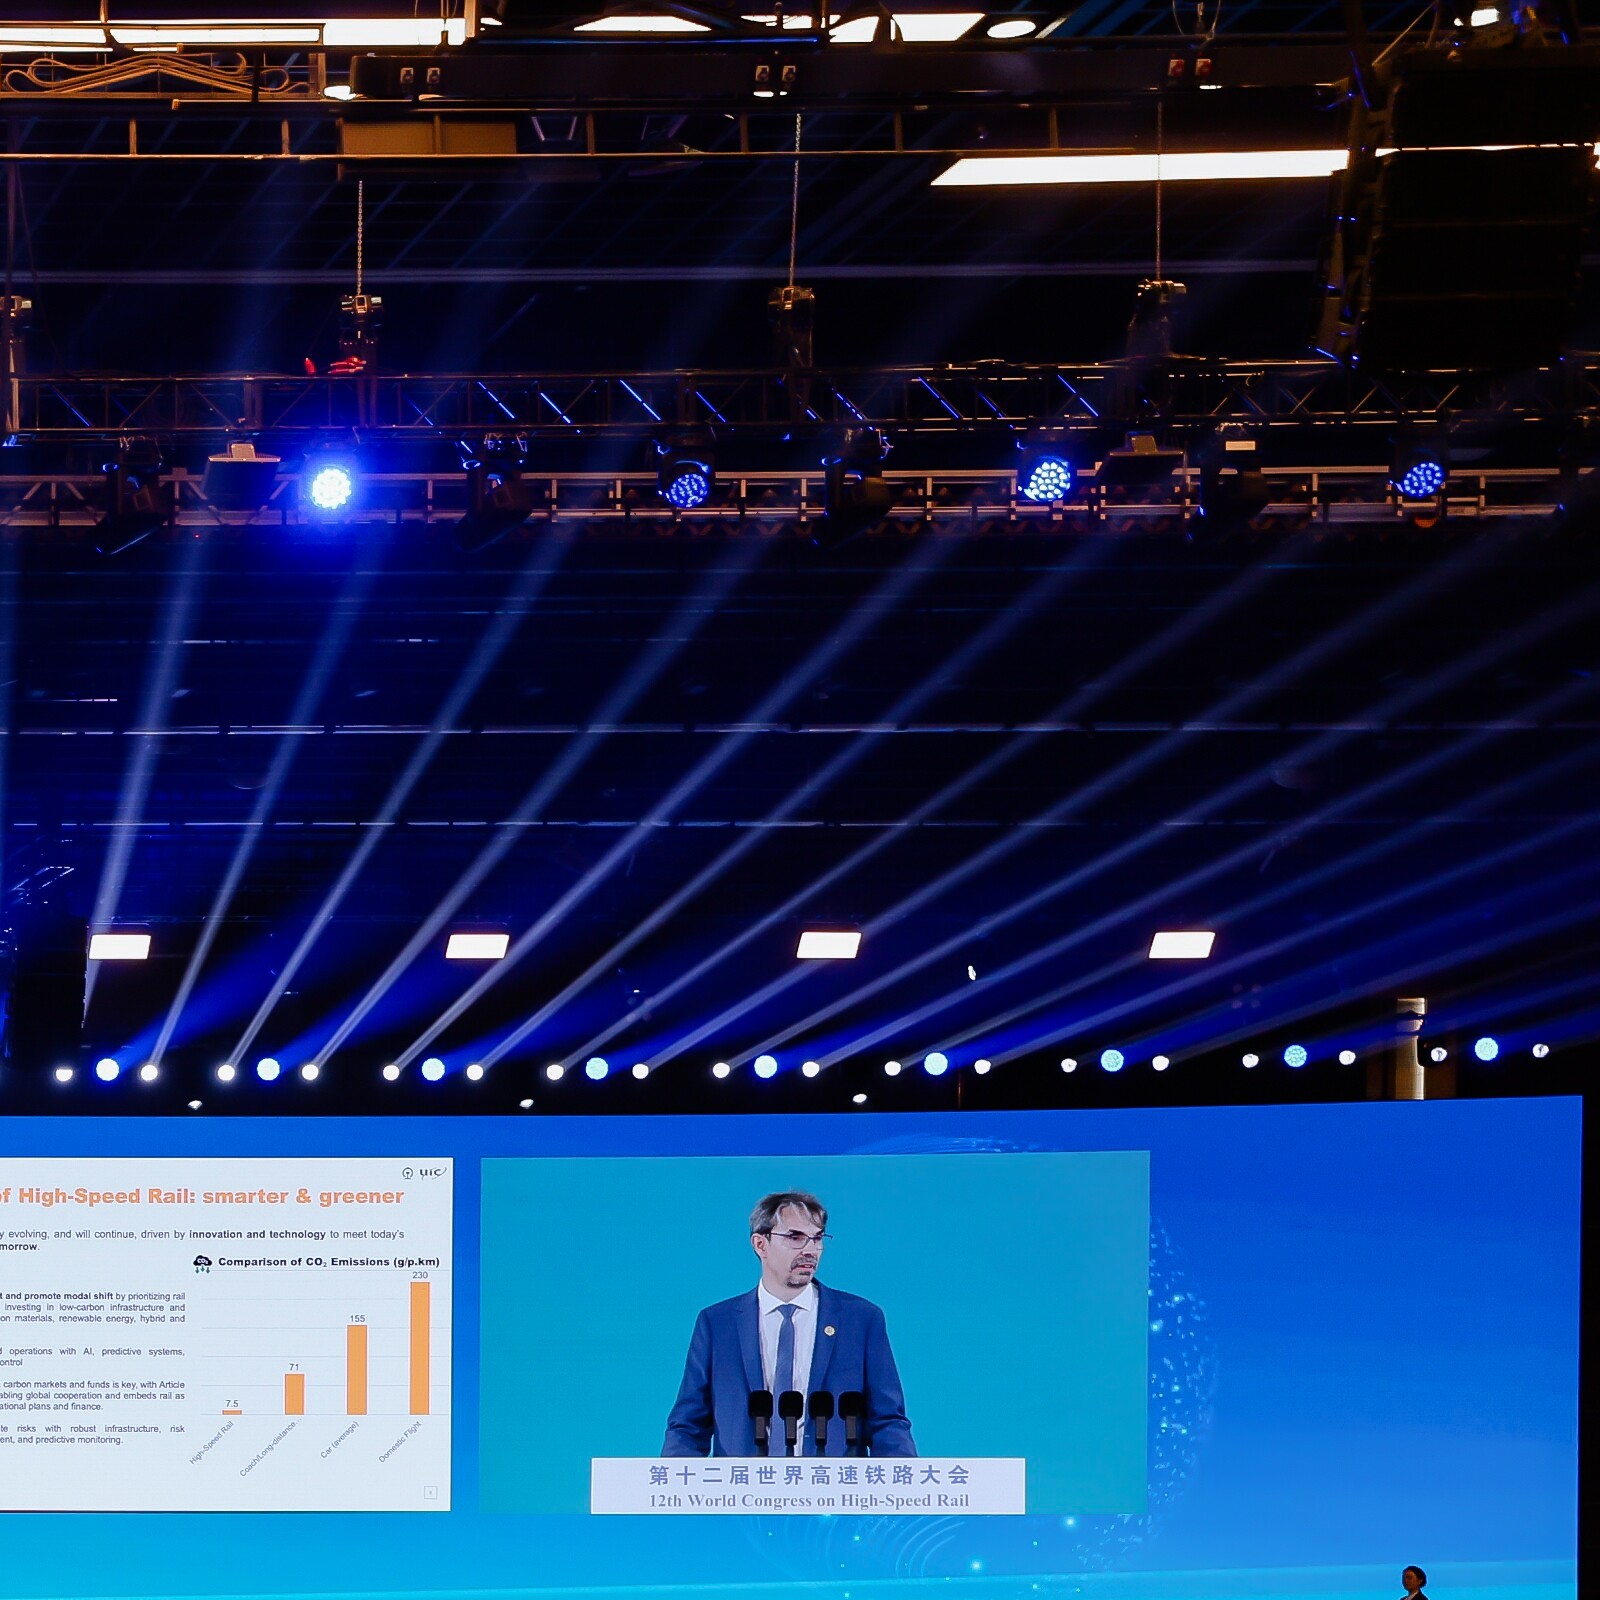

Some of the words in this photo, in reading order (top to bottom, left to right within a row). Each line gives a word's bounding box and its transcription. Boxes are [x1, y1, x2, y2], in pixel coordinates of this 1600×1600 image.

[18, 1187, 140, 1208] High-Speed
[148, 1188, 195, 1204] Rail:
[202, 1188, 289, 1204] smarter
[296, 1188, 312, 1204] &
[319, 1192, 405, 1208] greener
[8, 1229, 50, 1240] evolving,
[53, 1229, 72, 1238] and
[75, 1229, 91, 1238] will
[94, 1229, 137, 1240] continue,
[141, 1229, 170, 1239] driven
[174, 1230, 185, 1241] by
[189, 1229, 243, 1239] innovation
[246, 1229, 266, 1239] and
[269, 1229, 326, 1241] technology
[330, 1230, 339, 1239] to
[343, 1230, 367, 1239] meet
[218, 1257, 287, 1268] Comparison
[290, 1257, 302, 1266] of
[331, 1257, 390, 1266] Emissions
[393, 1257, 440, 1268] (g/p.km)
[411, 1271, 429, 1279] 230
[349, 1314, 367, 1323] 155
[289, 1363, 299, 1371] 71
[3, 1380, 32, 1388] carbon
[34, 1380, 67, 1389] markets
[69, 1380, 85, 1388] and
[87, 1380, 110, 1389] funds
[121, 1380, 138, 1390] key,
[140, 1381, 157, 1389] with
[159, 1380, 185, 1389] Article
[225, 1399, 239, 1408] 7.5
[649, 1464, 969, 1486] 第十二届世界高速铁路大会
[650, 1494, 682, 1507] 12th
[687, 1494, 736, 1507] World
[741, 1494, 812, 1510] Congress
[817, 1497, 835, 1507] on
[841, 1494, 931, 1510] High-Speed
[937, 1494, 969, 1507] Rail
